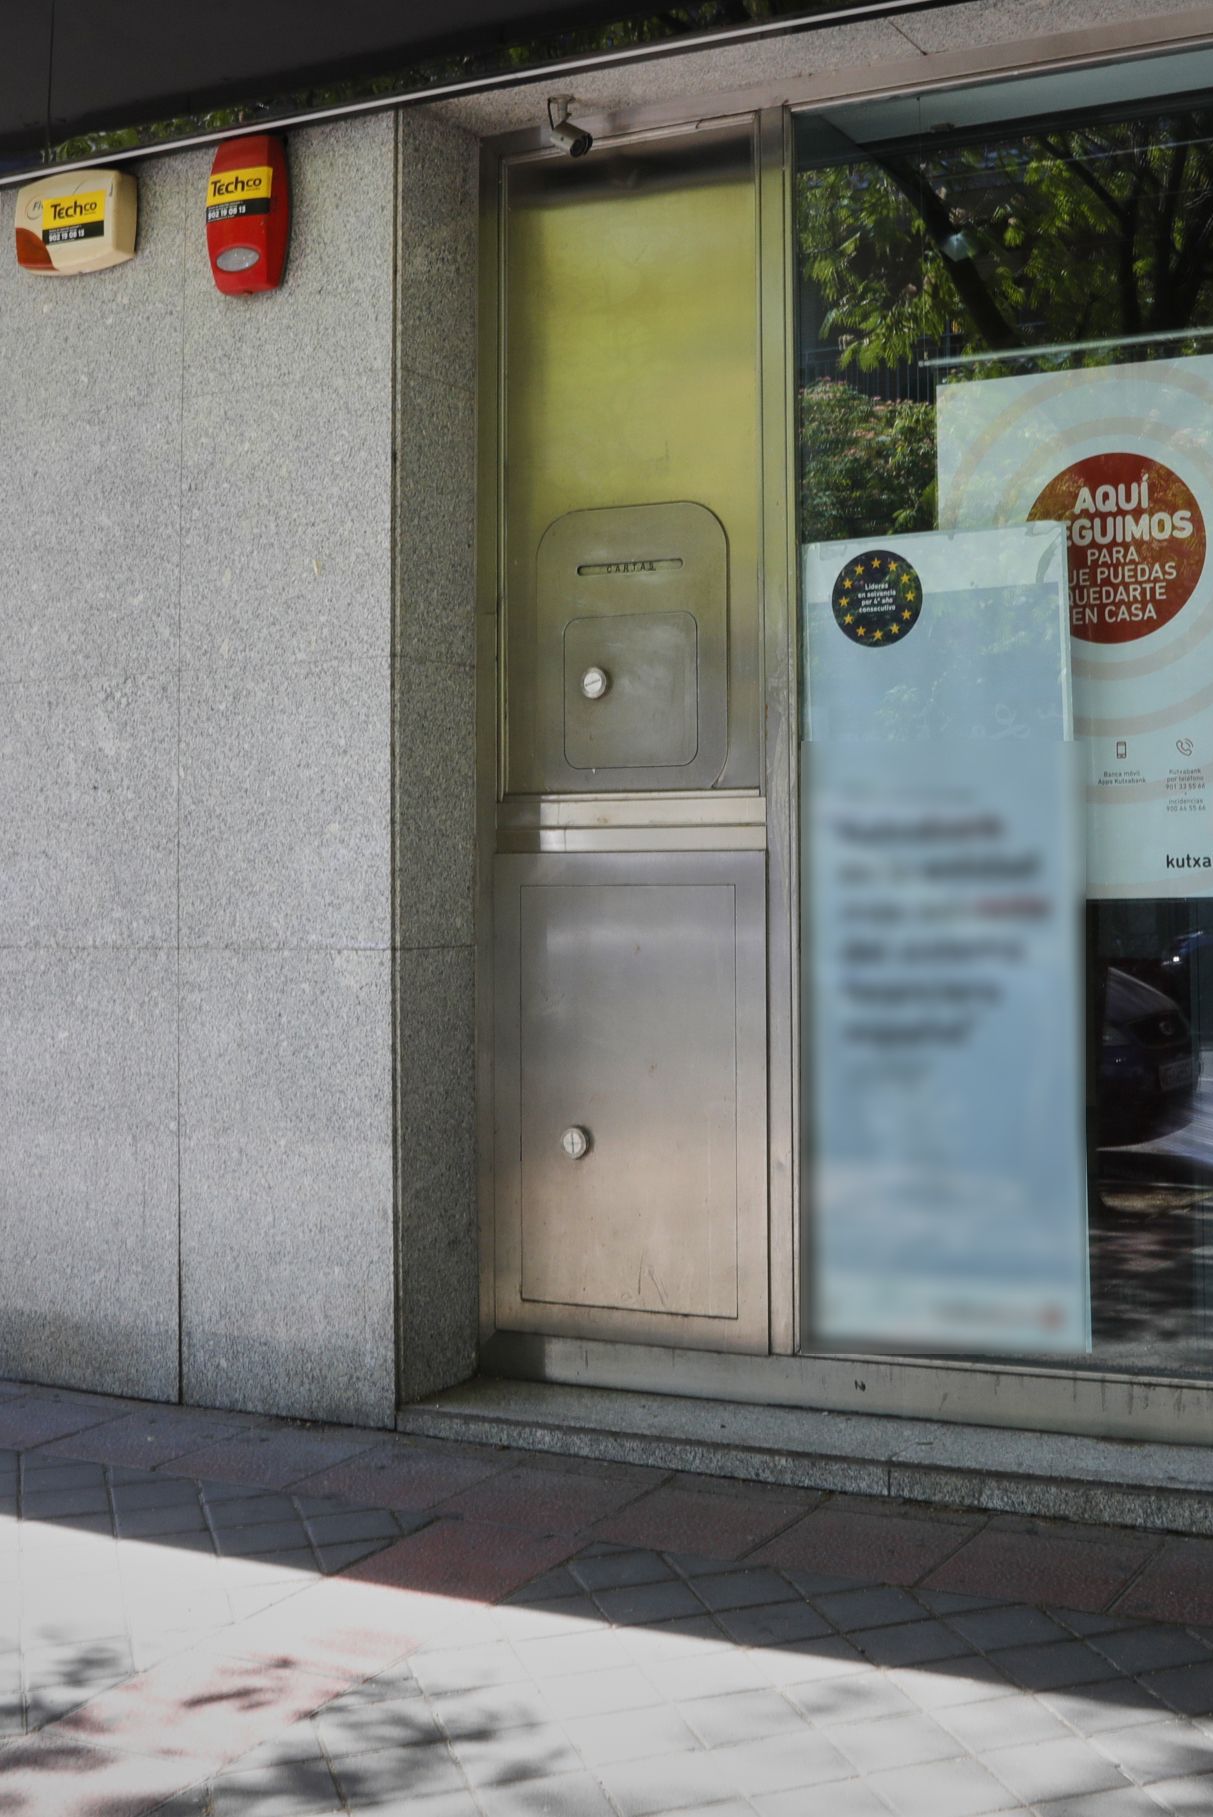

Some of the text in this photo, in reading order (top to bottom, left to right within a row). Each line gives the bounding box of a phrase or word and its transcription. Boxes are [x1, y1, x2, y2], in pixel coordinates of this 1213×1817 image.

[211, 176, 262, 198] Techco
[50, 200, 98, 220] Techco
[1073, 473, 1149, 514] AQUÍ
[1066, 510, 1194, 546] GUIMOS
[1087, 545, 1140, 566] PARA
[1068, 562, 1177, 586] UE PUEDAS
[1072, 602, 1158, 625] EN CASA
